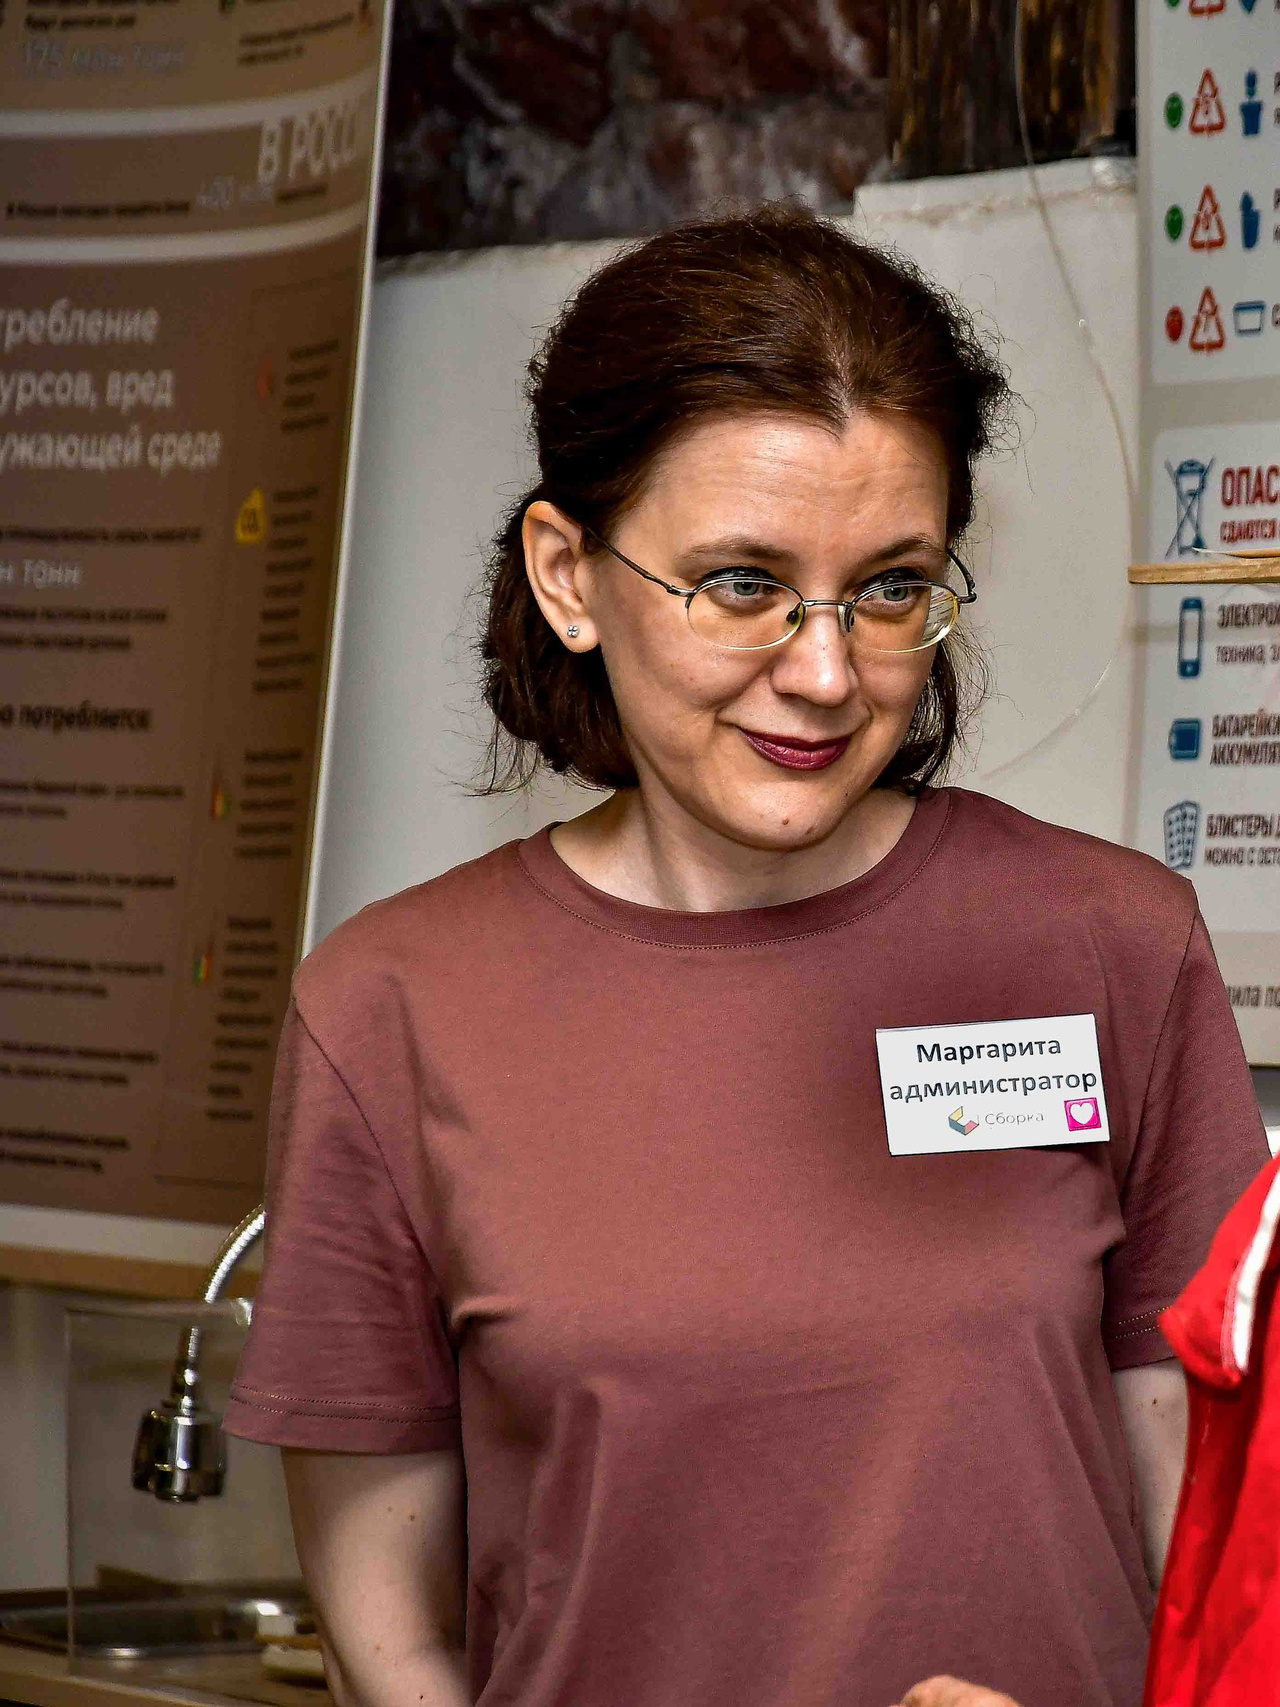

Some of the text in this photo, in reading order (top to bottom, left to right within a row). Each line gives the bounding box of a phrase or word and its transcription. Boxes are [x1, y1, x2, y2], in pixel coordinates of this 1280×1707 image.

[1220, 517, 1277, 544] СДАЮТСЯ
[1215, 643, 1266, 665] техника,
[1212, 707, 1280, 738] БАТАРЕЙКИ
[1206, 812, 1271, 838] БЛИСТЕРЫ
[1204, 846, 1244, 866] можно
[1246, 846, 1255, 865] с
[916, 1039, 1062, 1065] Маргарита
[889, 1071, 1098, 1103] администратор
[983, 1111, 1045, 1126] Сборка
